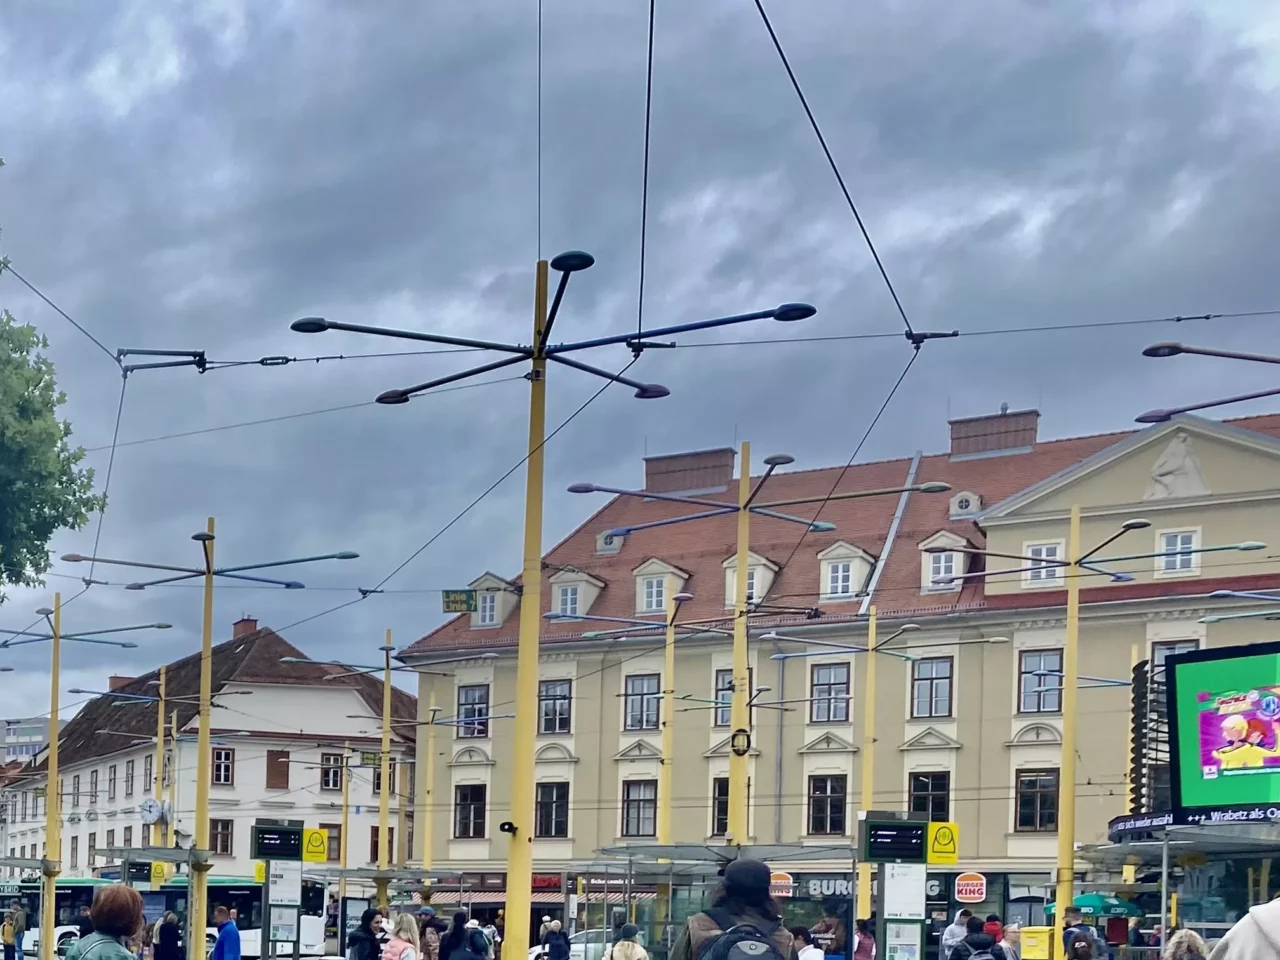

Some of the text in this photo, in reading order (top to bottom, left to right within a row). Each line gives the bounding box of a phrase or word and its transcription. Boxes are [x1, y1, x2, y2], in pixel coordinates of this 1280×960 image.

[443, 592, 467, 601] Linie
[444, 601, 467, 611] Linie
[1211, 811, 1247, 821] Wrabetz
[1249, 808, 1264, 819] als
[956, 888, 984, 896] KING
